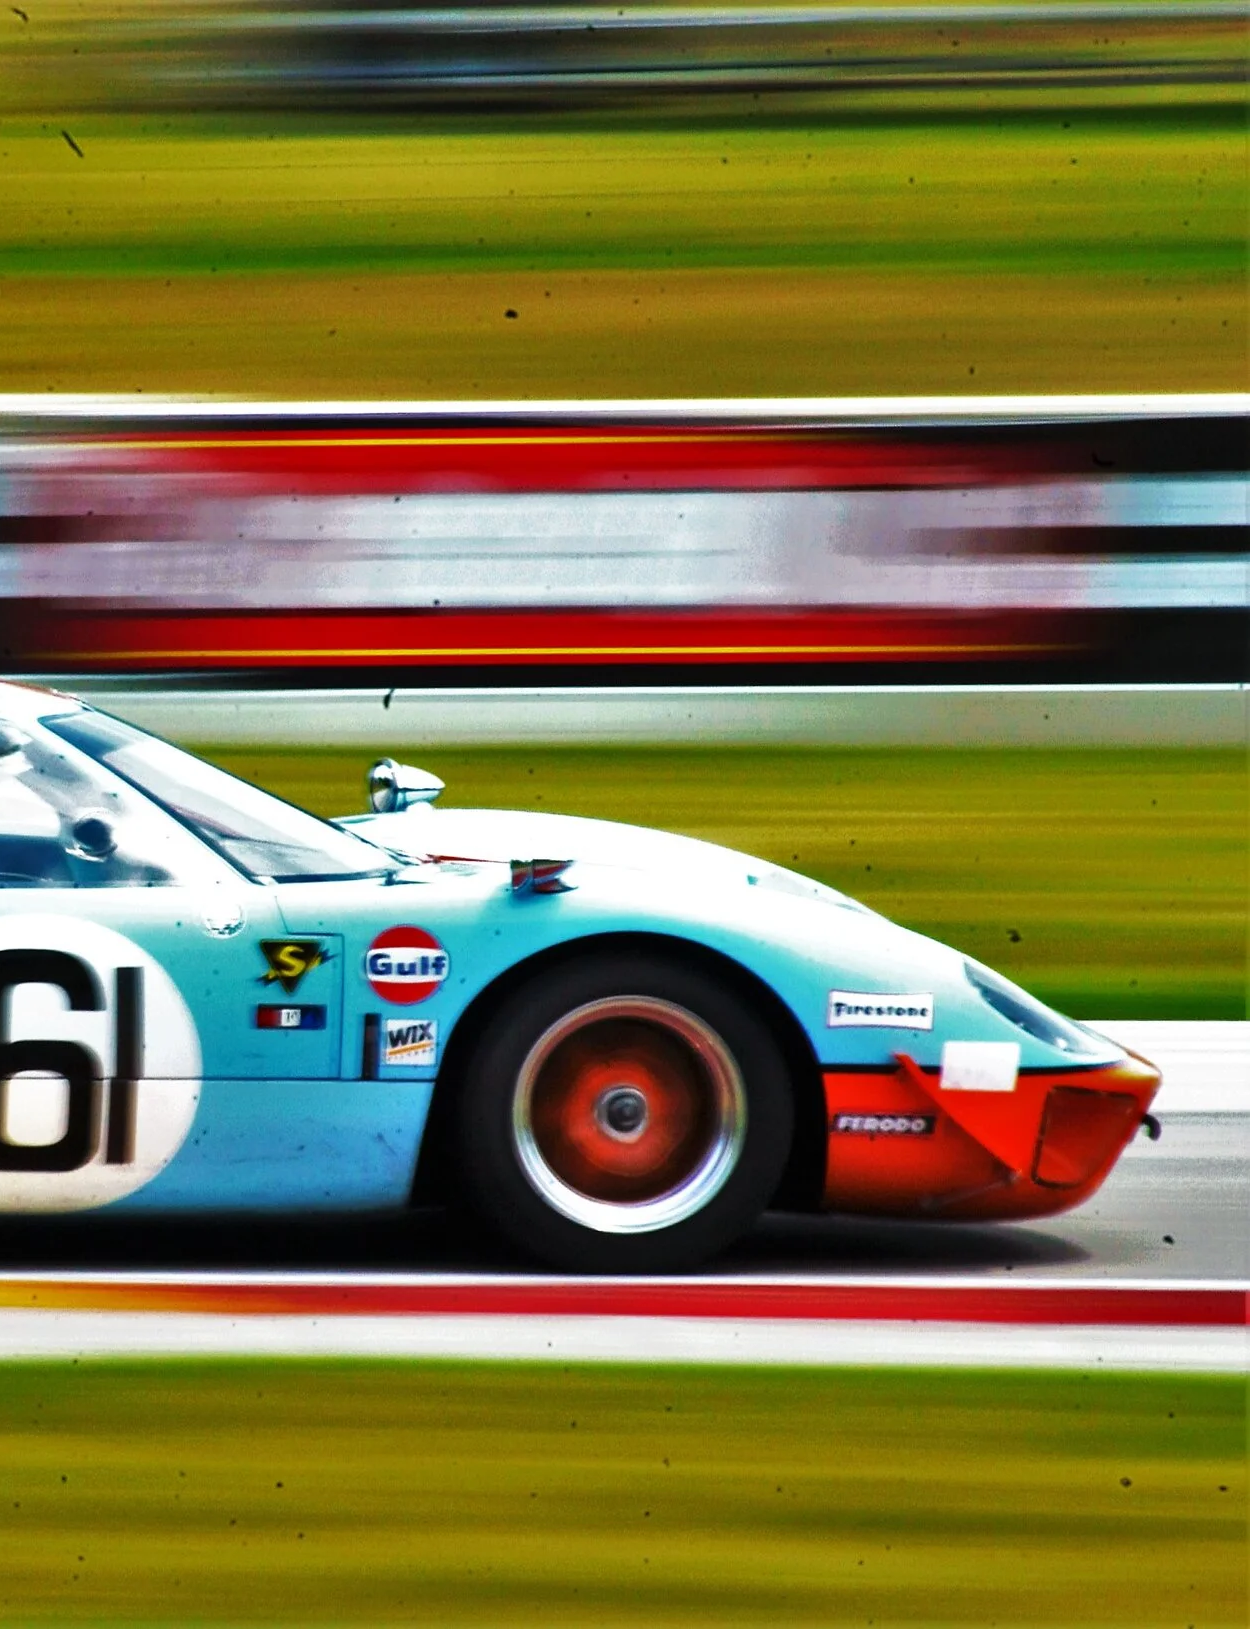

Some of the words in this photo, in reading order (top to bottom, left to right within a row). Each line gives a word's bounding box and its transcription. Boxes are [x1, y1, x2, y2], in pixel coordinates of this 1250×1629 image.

[368, 953, 447, 976] Gulf
[834, 1002, 928, 1017] Firestone
[388, 1022, 434, 1048] WIX
[838, 1116, 926, 1132] FERODO
